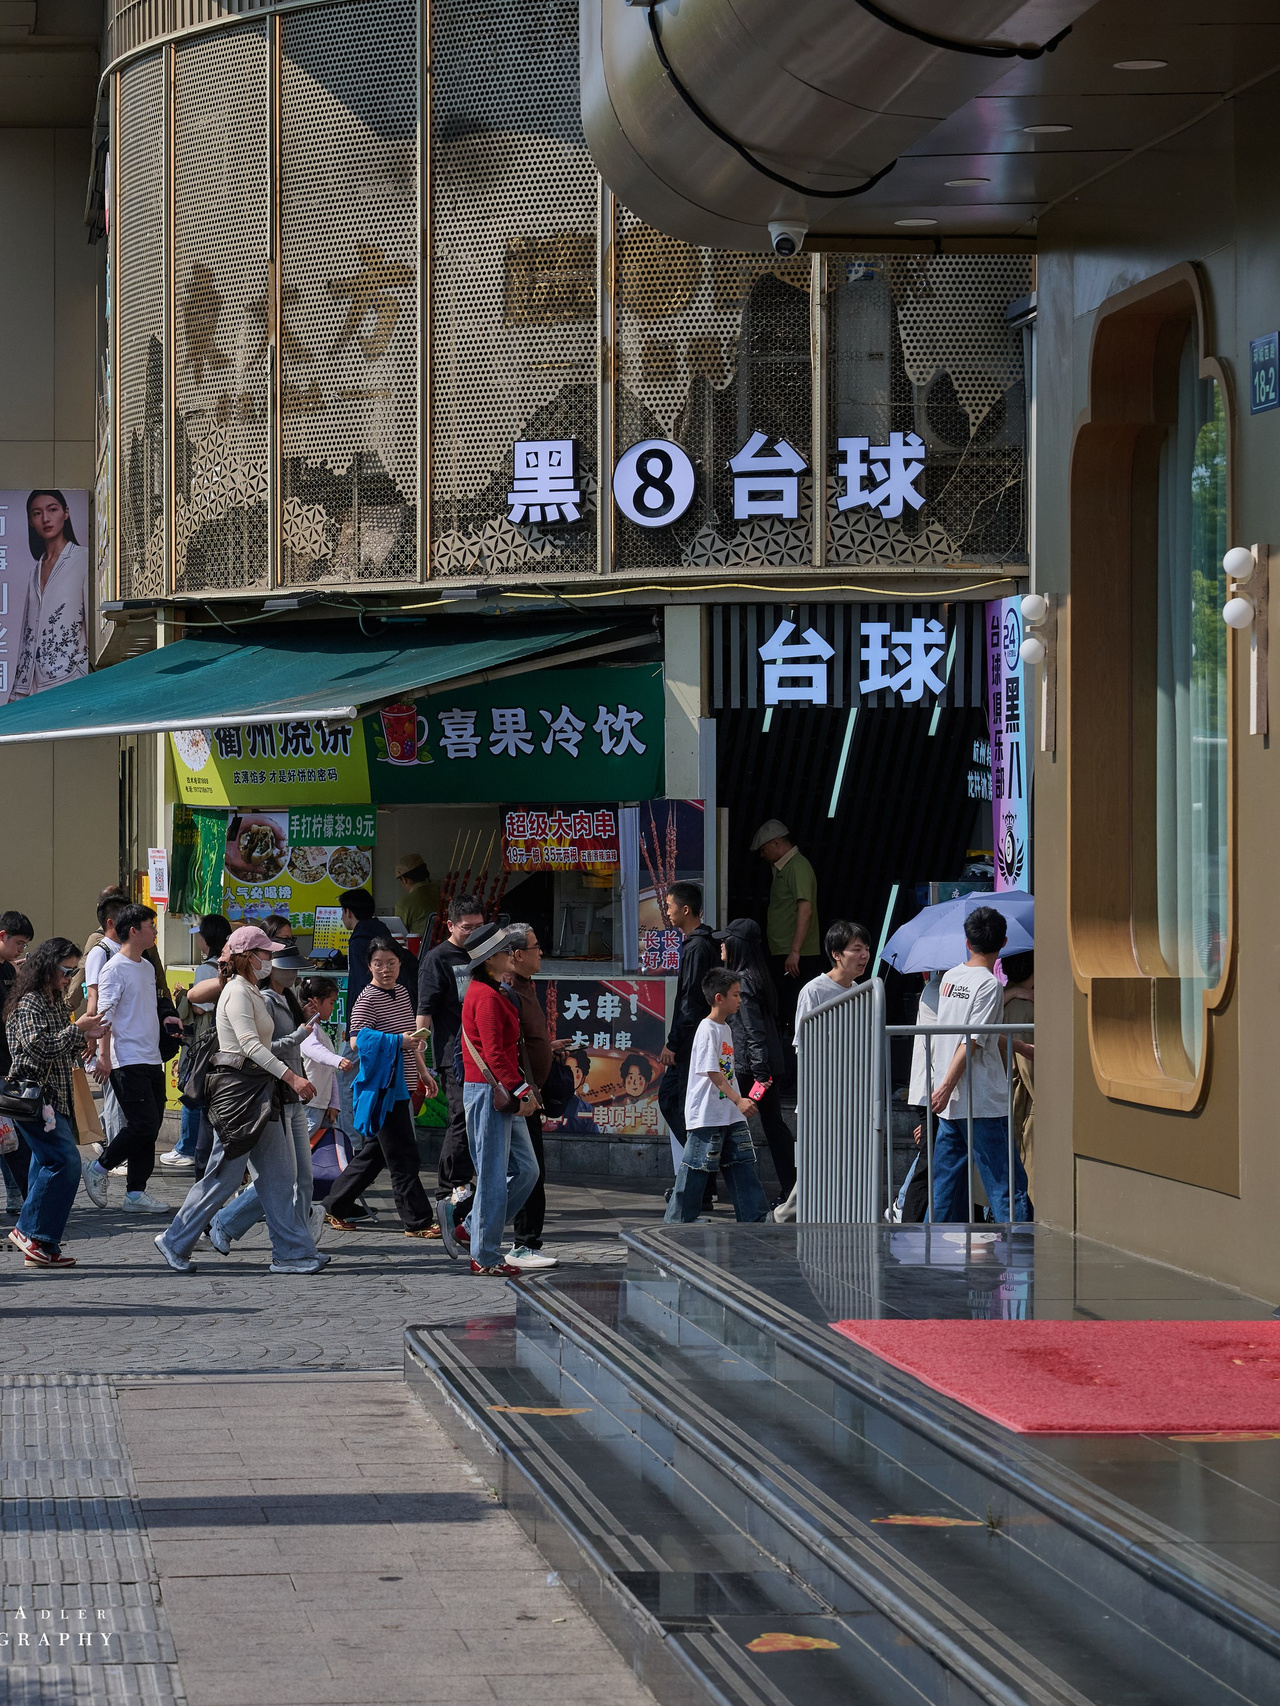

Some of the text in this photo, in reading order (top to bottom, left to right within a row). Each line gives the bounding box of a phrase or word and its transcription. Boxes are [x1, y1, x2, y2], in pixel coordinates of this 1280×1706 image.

[1254, 367, 1276, 403] 18-2
[758, 617, 946, 705] 台球
[991, 615, 1004, 800] 台球俱乐部
[437, 704, 647, 759] 喜果冷饮
[1005, 676, 1022, 800] 黑八
[290, 813, 375, 839] 手打柠檬茶9.9元
[506, 810, 616, 840] 超级大肉串
[543, 846, 579, 863] 35元两根
[642, 930, 686, 950] 长长
[571, 1031, 632, 1050] 大肉串
[577, 1105, 658, 1128] 一串顶十串
